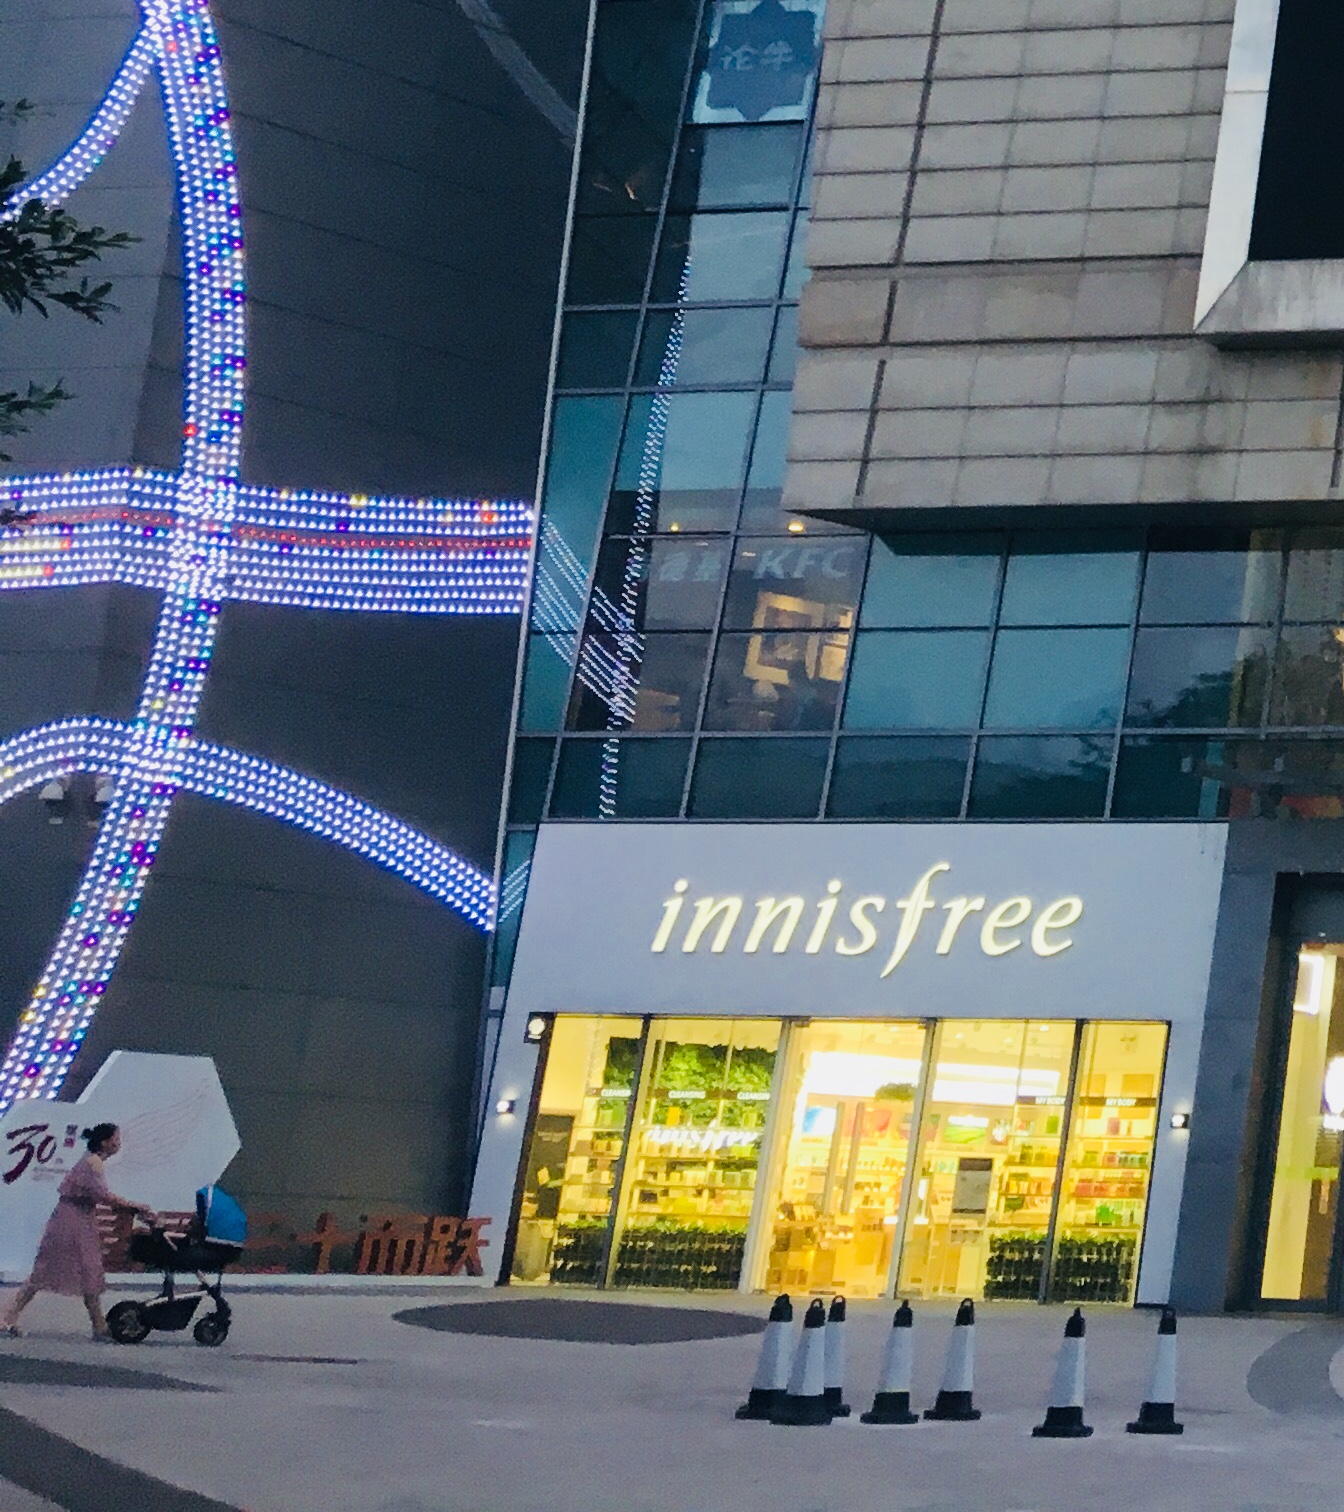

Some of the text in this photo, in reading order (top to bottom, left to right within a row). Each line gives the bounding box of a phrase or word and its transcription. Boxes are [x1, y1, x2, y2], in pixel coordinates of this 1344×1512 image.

[754, 543, 856, 580] KFC
[649, 862, 1084, 979] innisfree
[2, 1123, 57, 1185] 30
